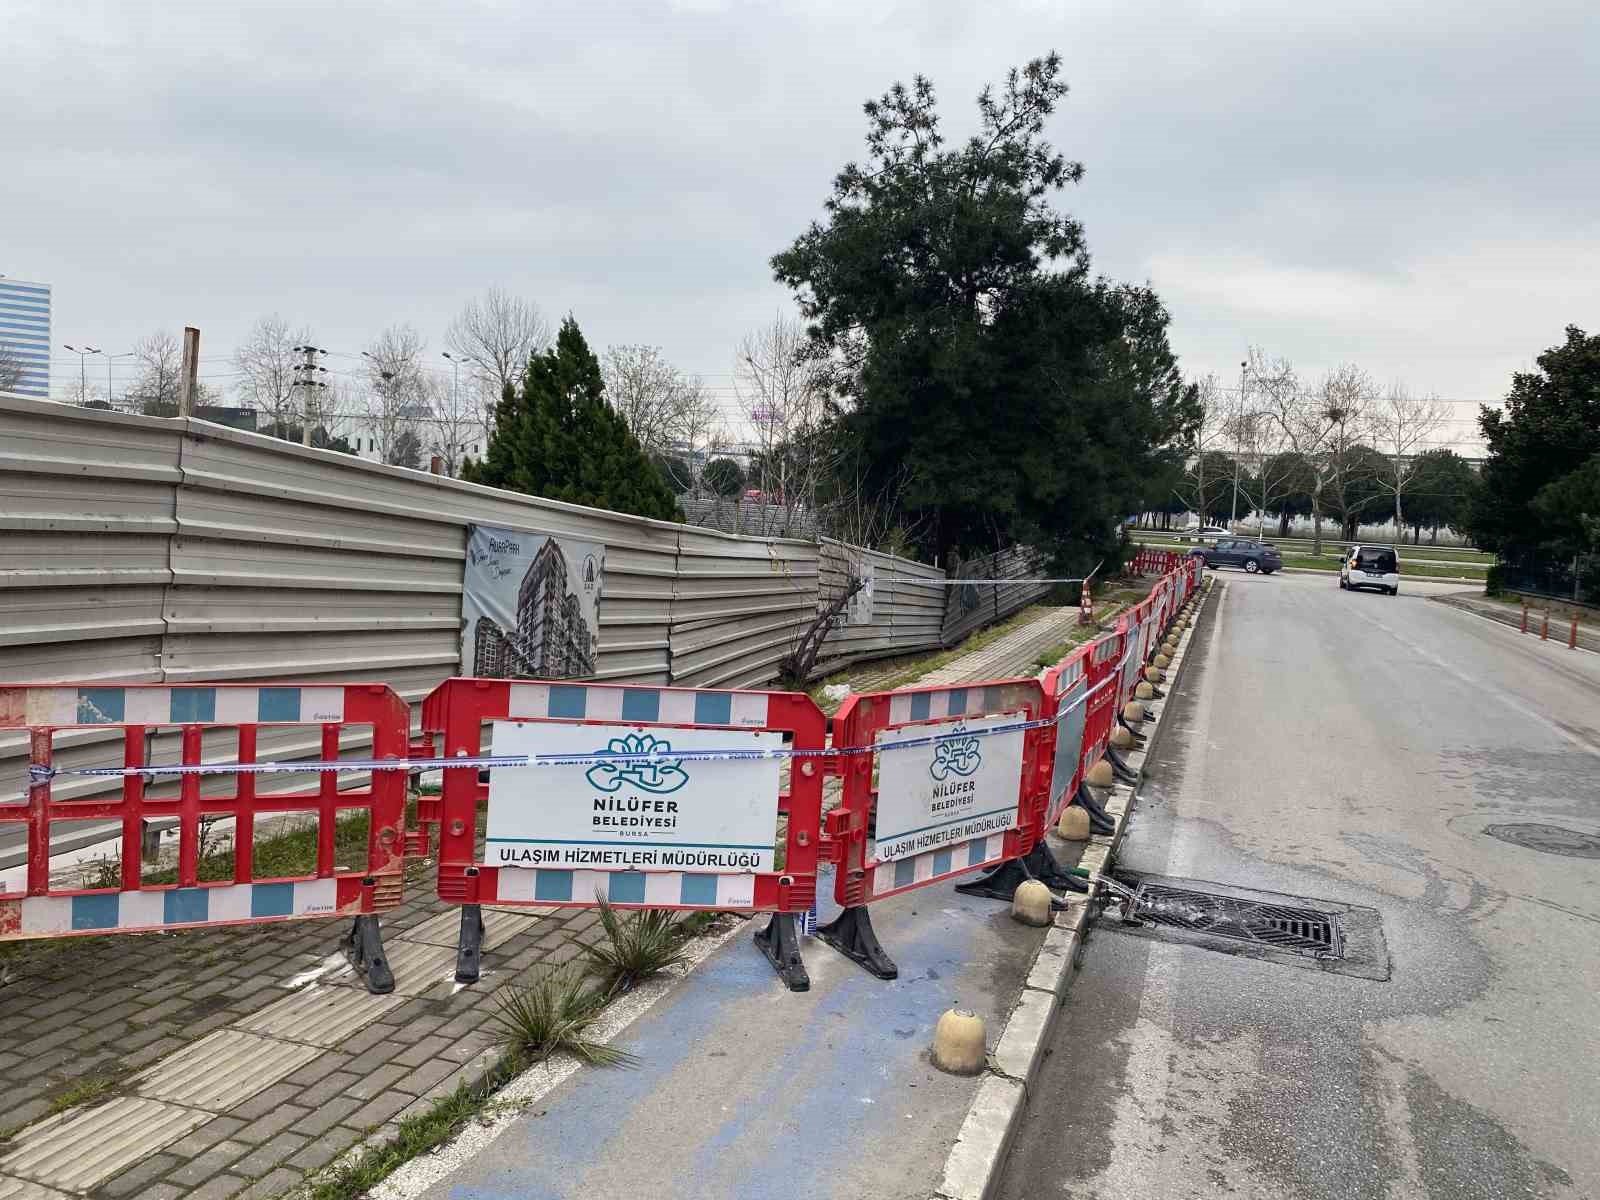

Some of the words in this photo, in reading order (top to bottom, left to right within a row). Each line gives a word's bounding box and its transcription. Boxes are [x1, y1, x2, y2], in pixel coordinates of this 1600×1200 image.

[932, 781, 975, 799] NİLÜFER
[593, 796, 678, 813] NİLÜFER
[931, 792, 974, 812] BELEDİYESİ
[592, 816, 676, 828] BELEDİYESİ
[884, 842, 915, 858] ULAŞIM
[917, 827, 963, 848] HİZMETLERİ
[500, 848, 560, 864] ULAŞIM
[564, 847, 657, 865] HİZMETLERİ
[662, 851, 760, 868] MÜDÜRLÜĞÜ
